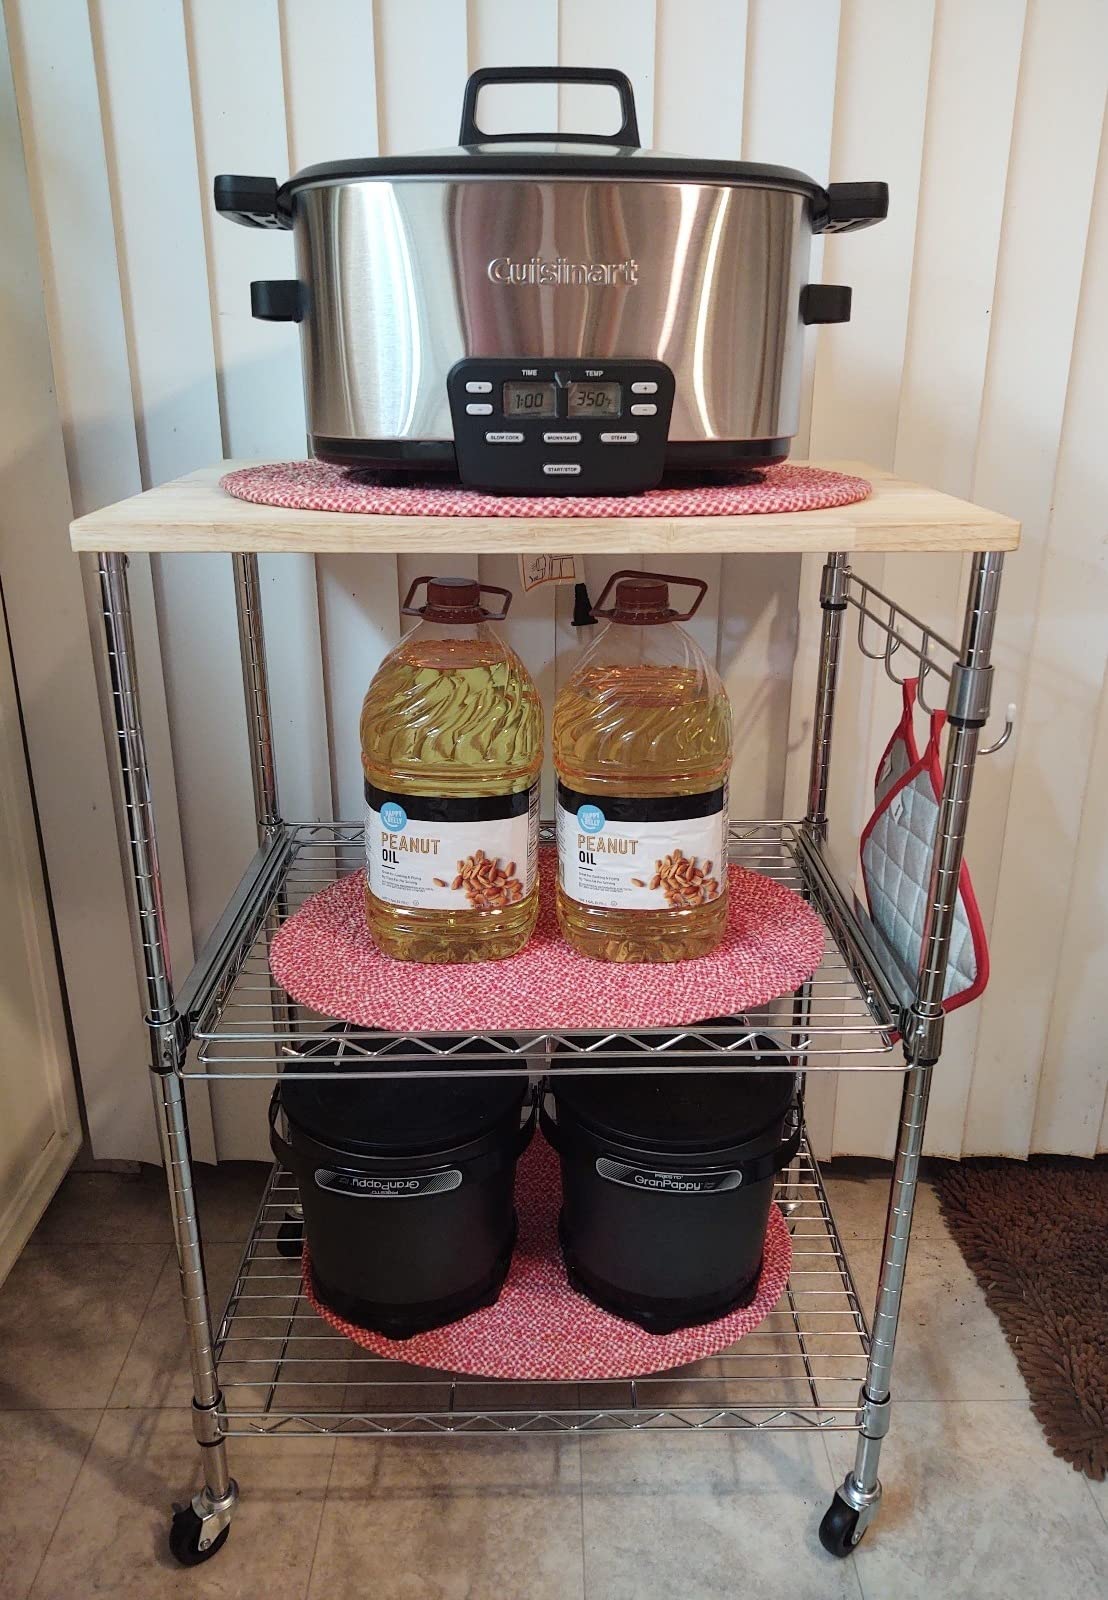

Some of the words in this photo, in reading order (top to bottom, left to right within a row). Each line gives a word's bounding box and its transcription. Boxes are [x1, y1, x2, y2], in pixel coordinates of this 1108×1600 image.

[487, 257, 640, 286] Cuisinart
[516, 392, 544, 409] 1:00
[381, 832, 441, 855] PEANUT
[578, 834, 639, 855] PEANUT
[382, 848, 400, 864] OIL
[579, 850, 597, 865] OIL
[352, 1178, 420, 1191] GranPappy
[634, 1175, 701, 1191] GranPappy
